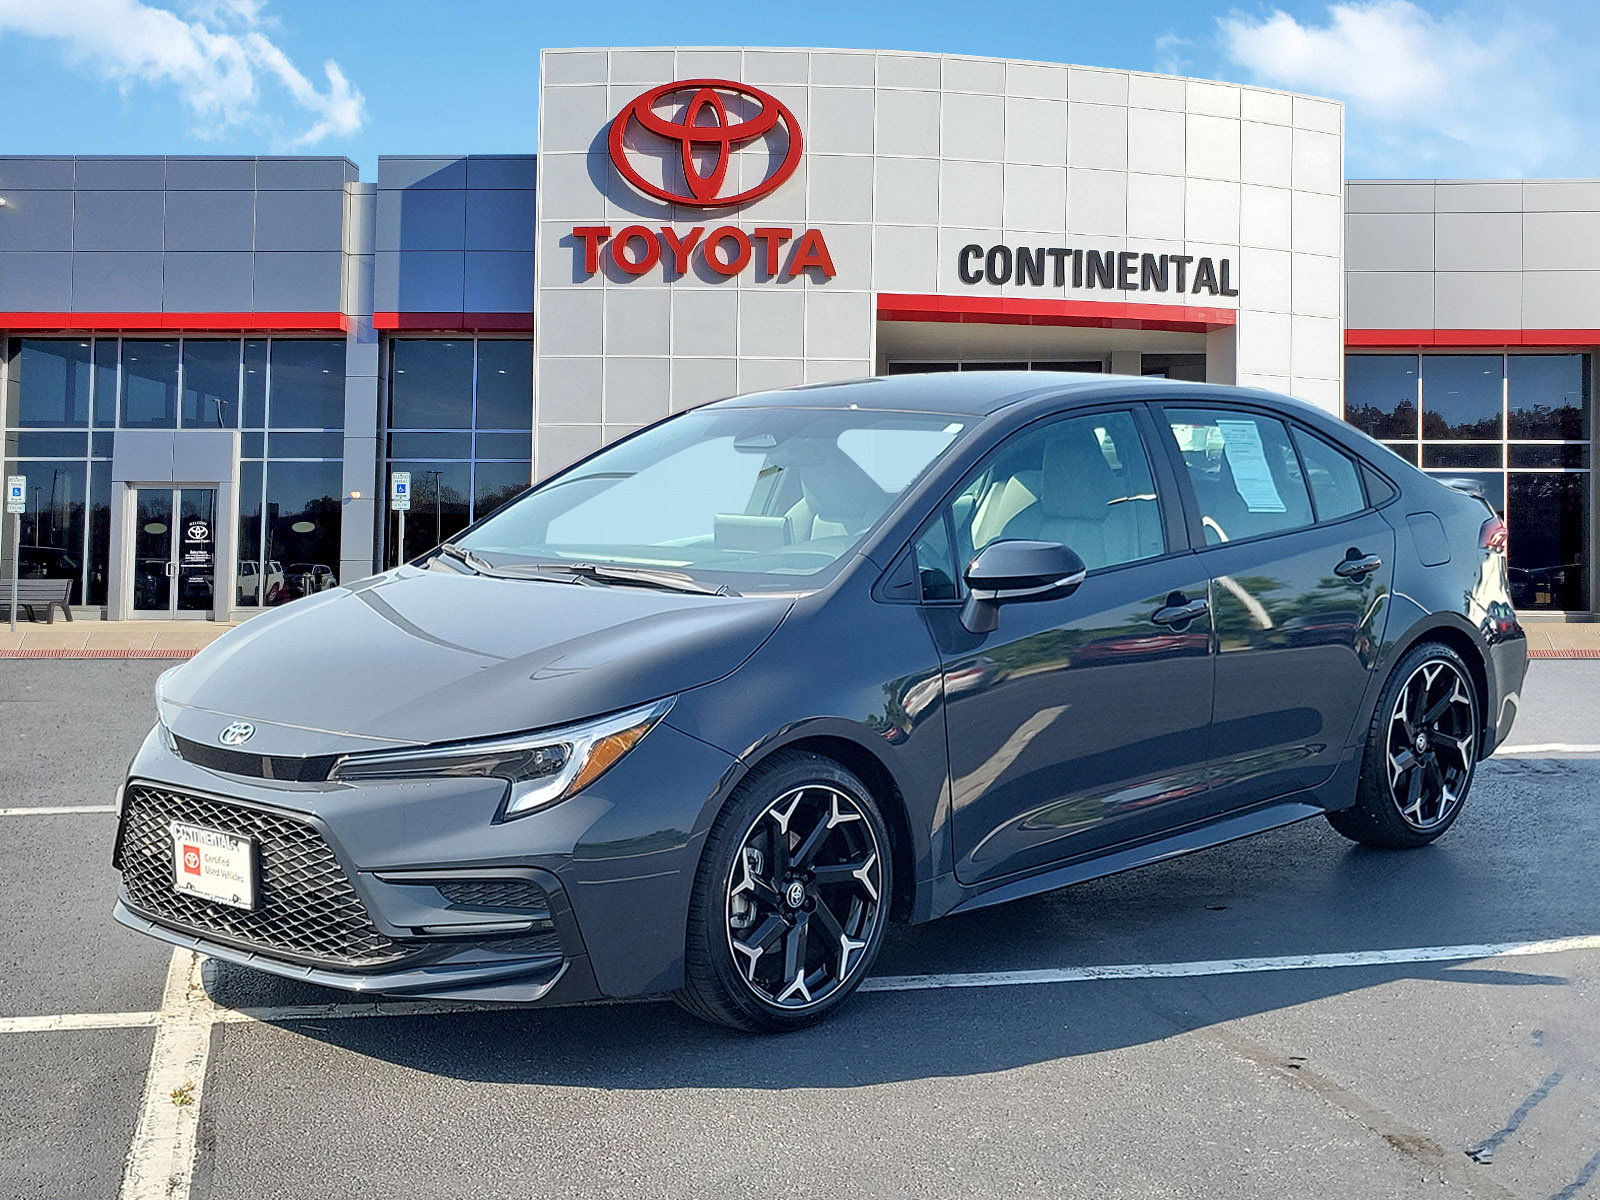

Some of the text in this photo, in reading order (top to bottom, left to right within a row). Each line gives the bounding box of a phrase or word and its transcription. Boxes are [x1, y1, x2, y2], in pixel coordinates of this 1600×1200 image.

[572, 225, 836, 277] TOYOTA
[958, 244, 1238, 297] CONTINENTAL
[173, 824, 233, 850] CONTINENTAL
[204, 853, 230, 867] Certified
[204, 865, 244, 883] Used Vehicles
